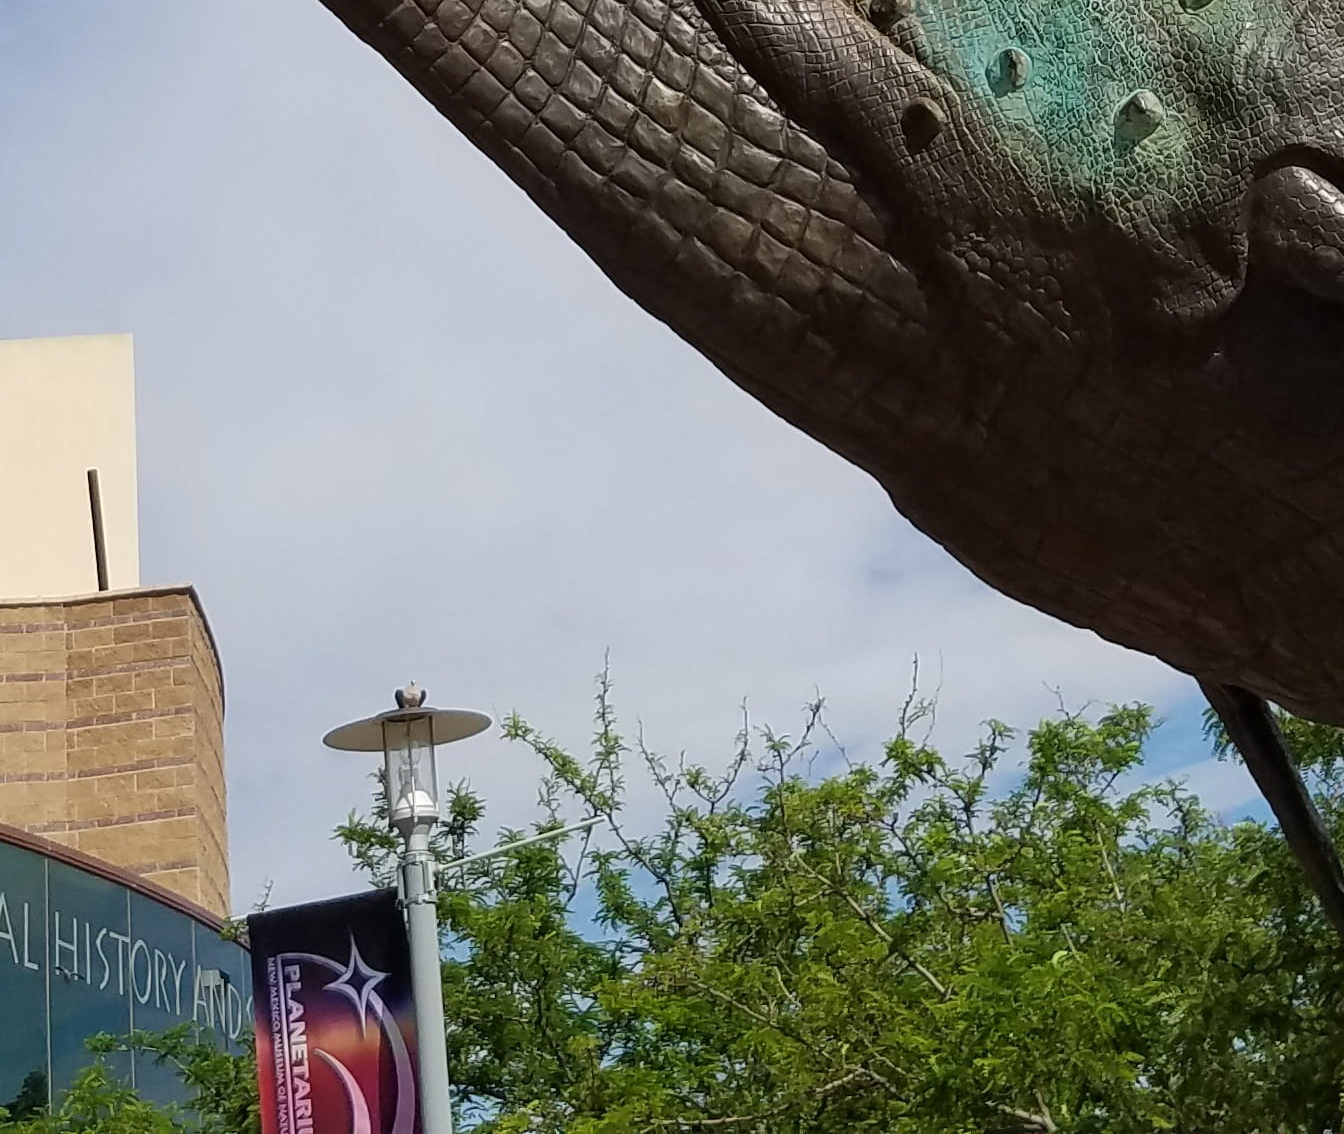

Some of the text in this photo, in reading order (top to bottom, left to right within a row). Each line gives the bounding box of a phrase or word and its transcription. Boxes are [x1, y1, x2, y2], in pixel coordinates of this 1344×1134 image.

[55, 910, 187, 1016] HISTORY
[193, 964, 243, 1040] AND
[267, 957, 277, 986] NEW
[270, 986, 281, 1033] MEXICO
[273, 1033, 286, 1087] MUSEUM
